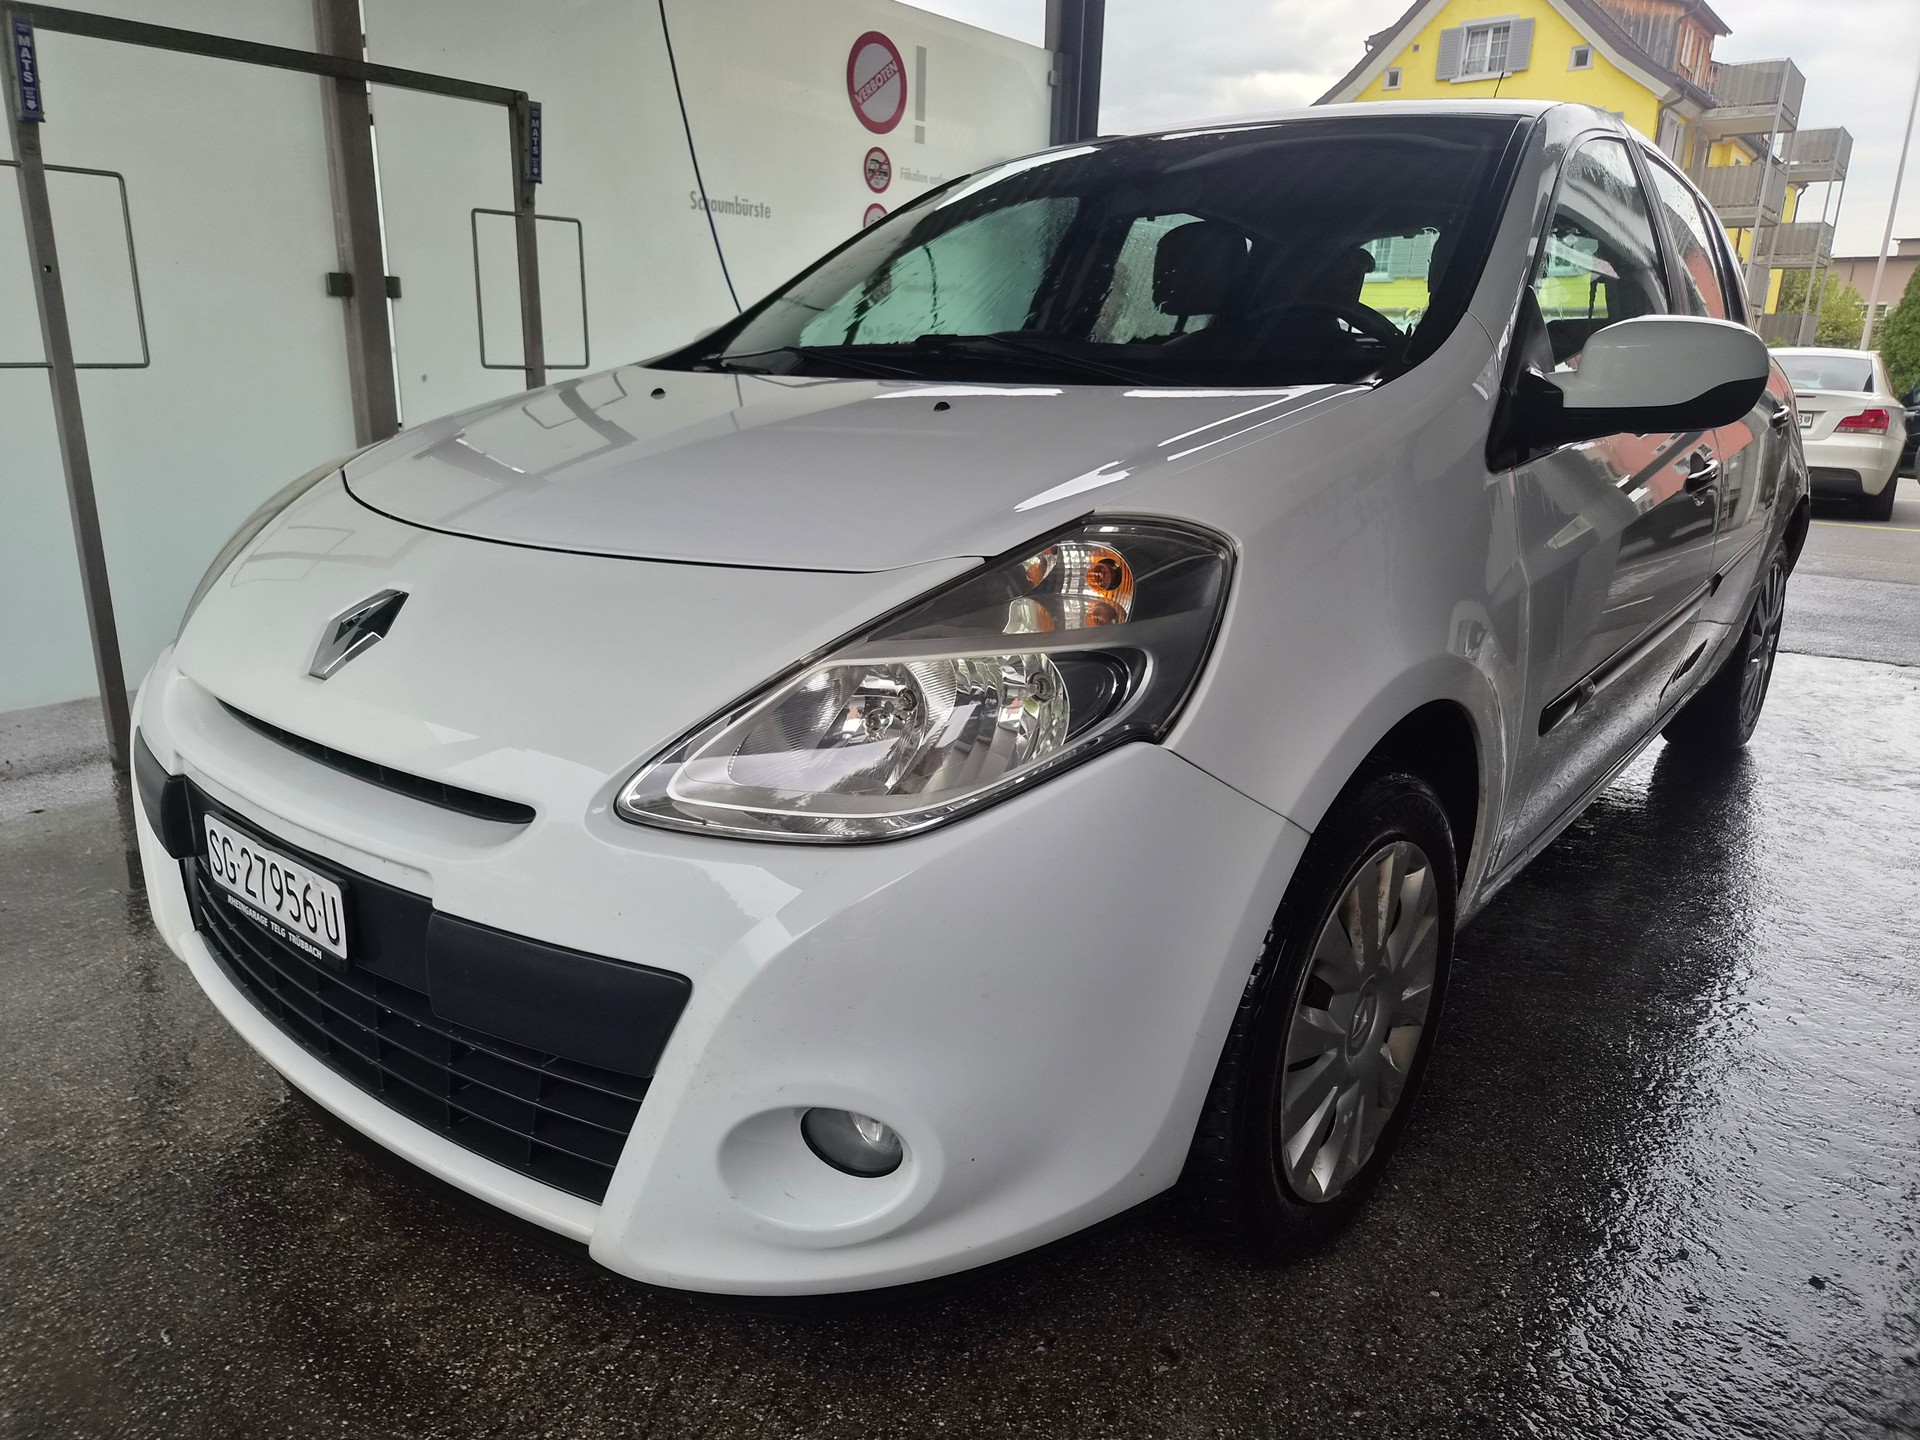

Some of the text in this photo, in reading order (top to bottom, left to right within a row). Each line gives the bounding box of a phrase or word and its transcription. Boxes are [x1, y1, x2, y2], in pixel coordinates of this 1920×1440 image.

[17, 34, 34, 83] MATS
[854, 60, 900, 105] VERBOTEN
[531, 119, 540, 155] MATS
[227, 894, 269, 928] RHEINGARAGE
[287, 931, 323, 960] TRÜBBACH
